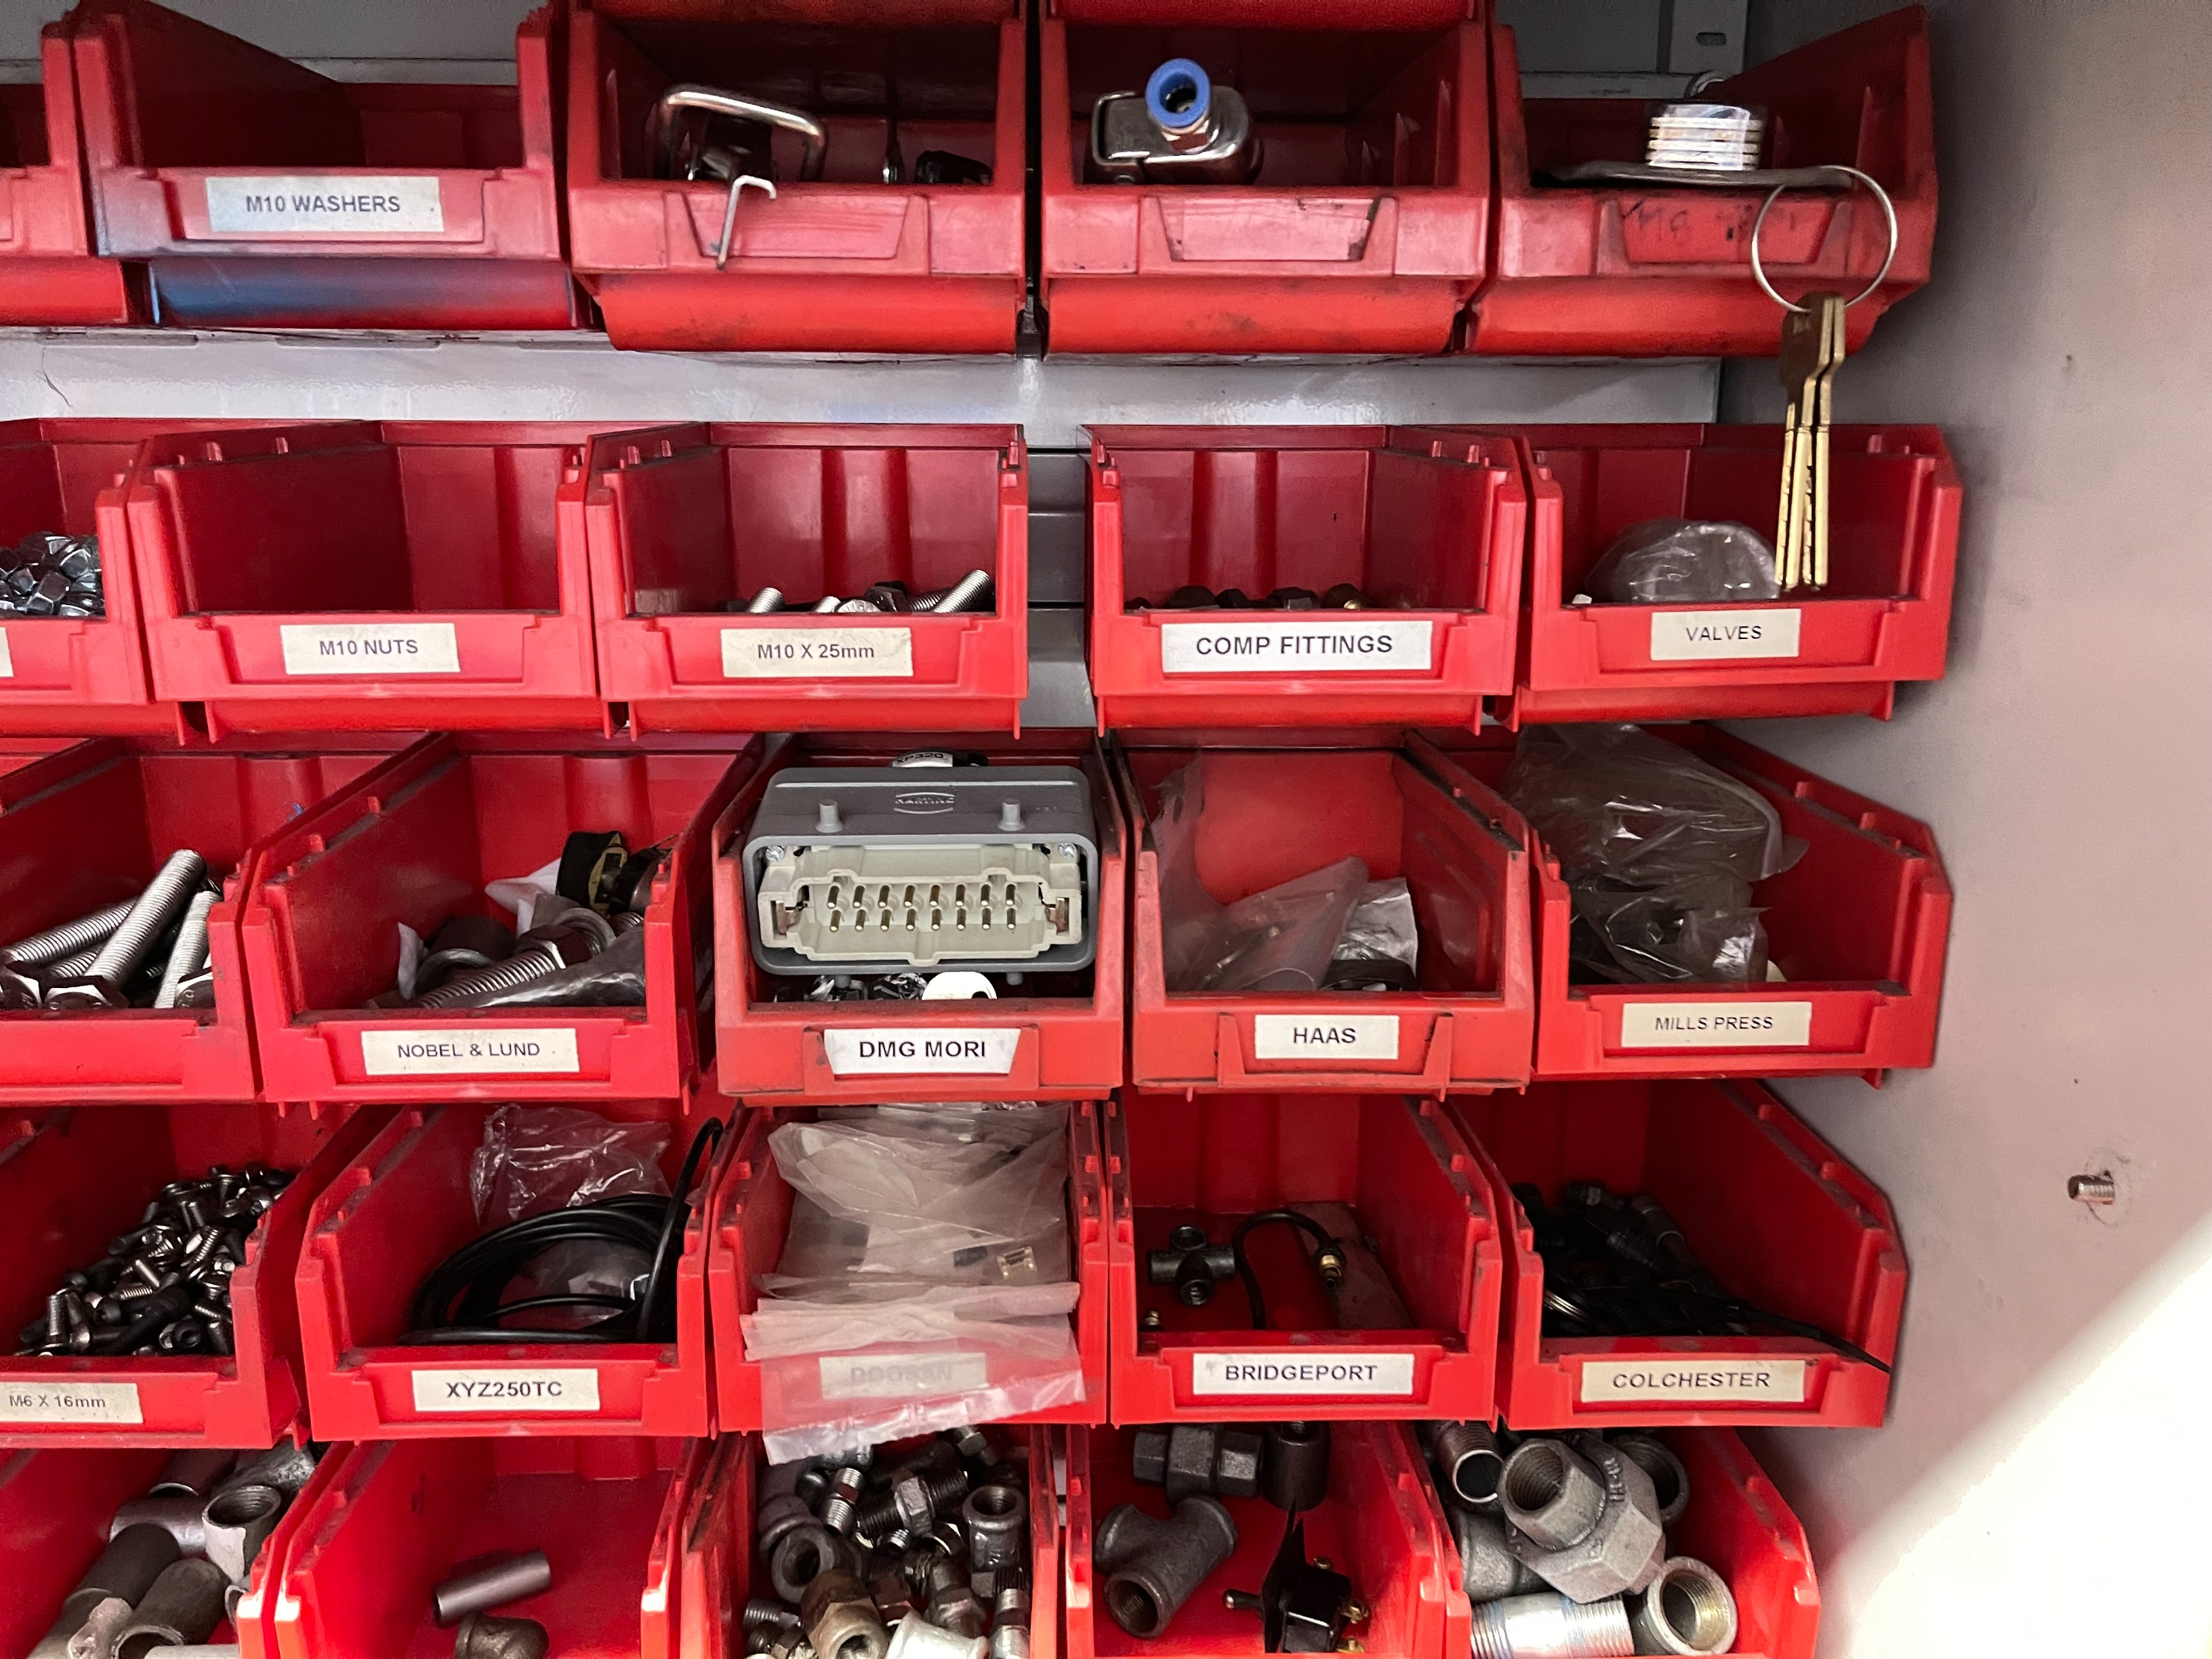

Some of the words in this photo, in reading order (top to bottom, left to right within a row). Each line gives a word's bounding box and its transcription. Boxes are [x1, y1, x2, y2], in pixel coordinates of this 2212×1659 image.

[246, 196, 286, 213] M10
[292, 195, 401, 213] WASHERS
[1685, 625, 1762, 642] VALVES
[319, 640, 359, 657] M10
[364, 640, 419, 655] NUTS
[758, 644, 795, 659] M10
[801, 644, 813, 659] X
[818, 644, 875, 659] 25mm
[1196, 637, 1271, 655] COMP
[1280, 636, 1393, 655] FITTINGS
[1655, 1017, 1708, 1031] MILLS
[1714, 1016, 1774, 1030] PRESS
[1293, 1027, 1357, 1044] HAAS
[398, 1044, 464, 1059] NOBEL
[470, 1044, 483, 1057] &
[489, 1042, 541, 1057] LUND
[859, 1042, 916, 1059] DMG
[925, 1042, 986, 1058] MORI
[1226, 1365, 1378, 1381] BRIDGEPORT
[1613, 1372, 1771, 1389] COLCHESTER
[447, 1381, 563, 1399] XYZ250TC
[38, 1395, 49, 1408] X
[54, 1395, 106, 1408] 16mm
